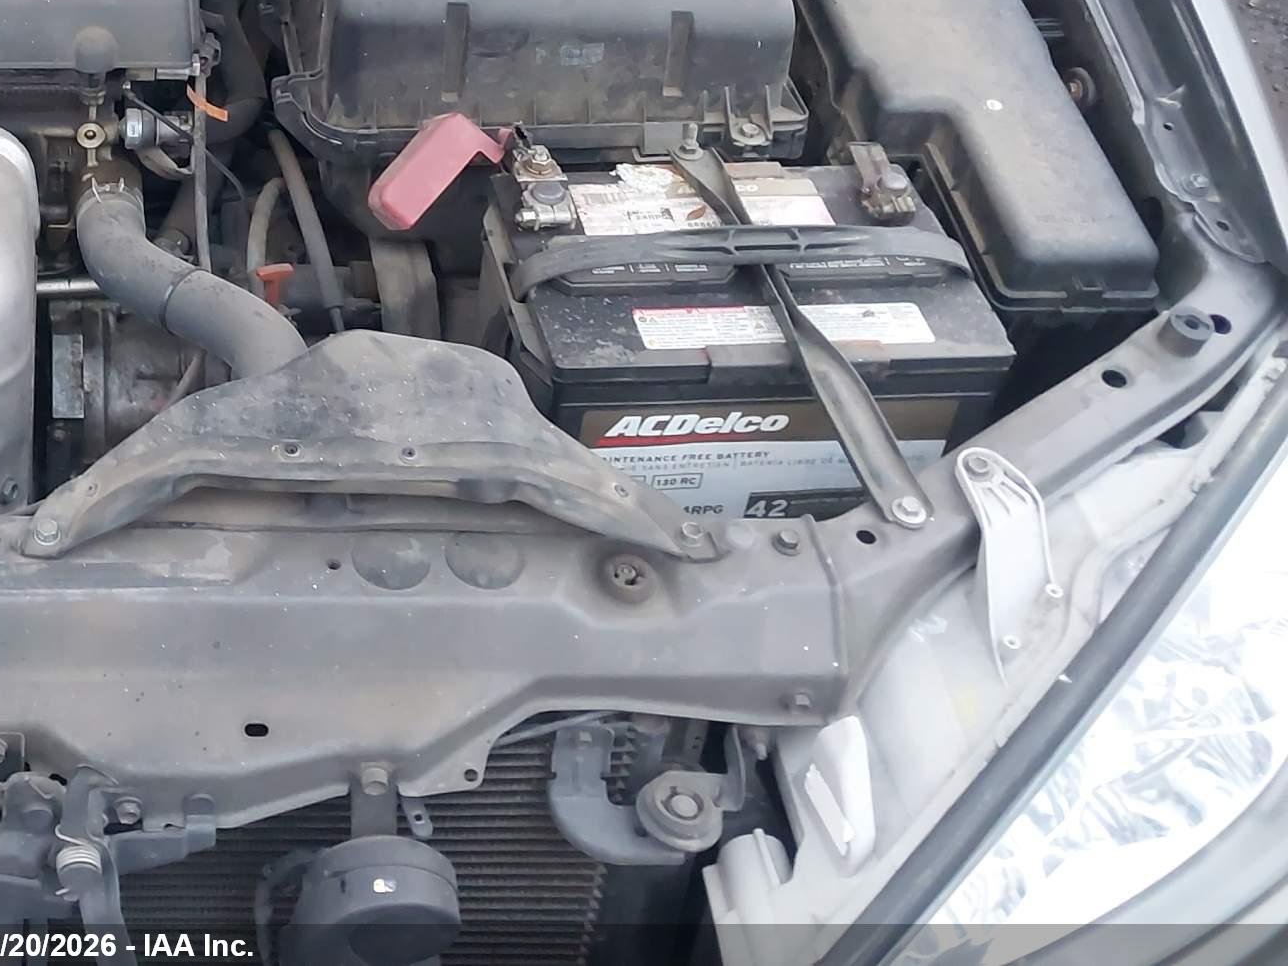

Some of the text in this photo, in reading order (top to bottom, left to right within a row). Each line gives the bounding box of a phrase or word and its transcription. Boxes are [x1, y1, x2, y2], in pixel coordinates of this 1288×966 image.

[604, 411, 790, 437] ACDelco
[681, 453, 712, 462] FREE
[716, 451, 771, 461] BATTERY
